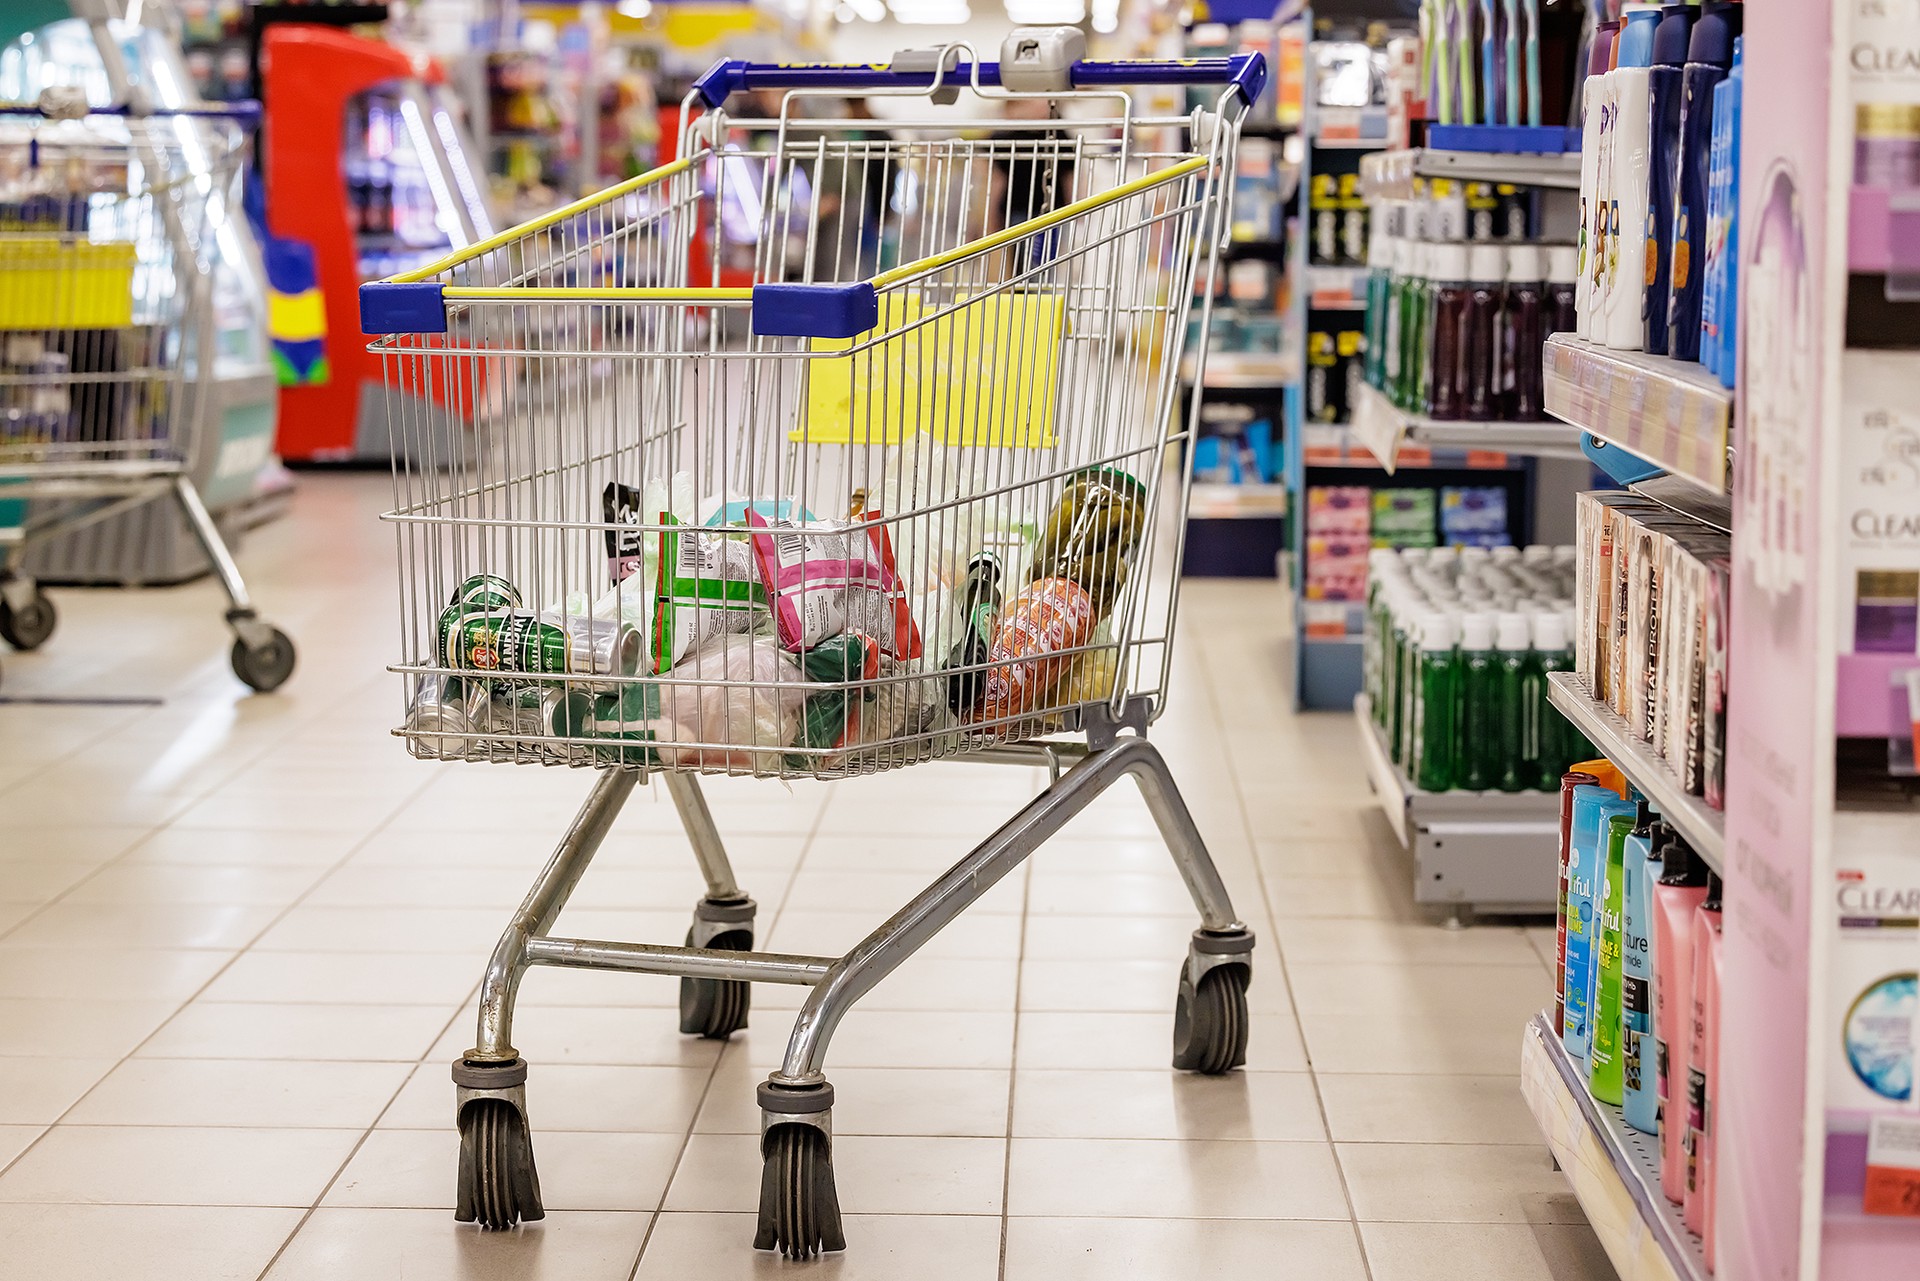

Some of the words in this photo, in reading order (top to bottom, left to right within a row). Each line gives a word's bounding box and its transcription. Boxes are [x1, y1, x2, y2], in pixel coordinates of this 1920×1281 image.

[1851, 508, 1920, 540] CLEA
[502, 618, 527, 672] LANDIA
[1648, 566, 1657, 657] PROTEIN
[1646, 660, 1656, 739] WHEAT
[1686, 706, 1698, 790] WHEAT
